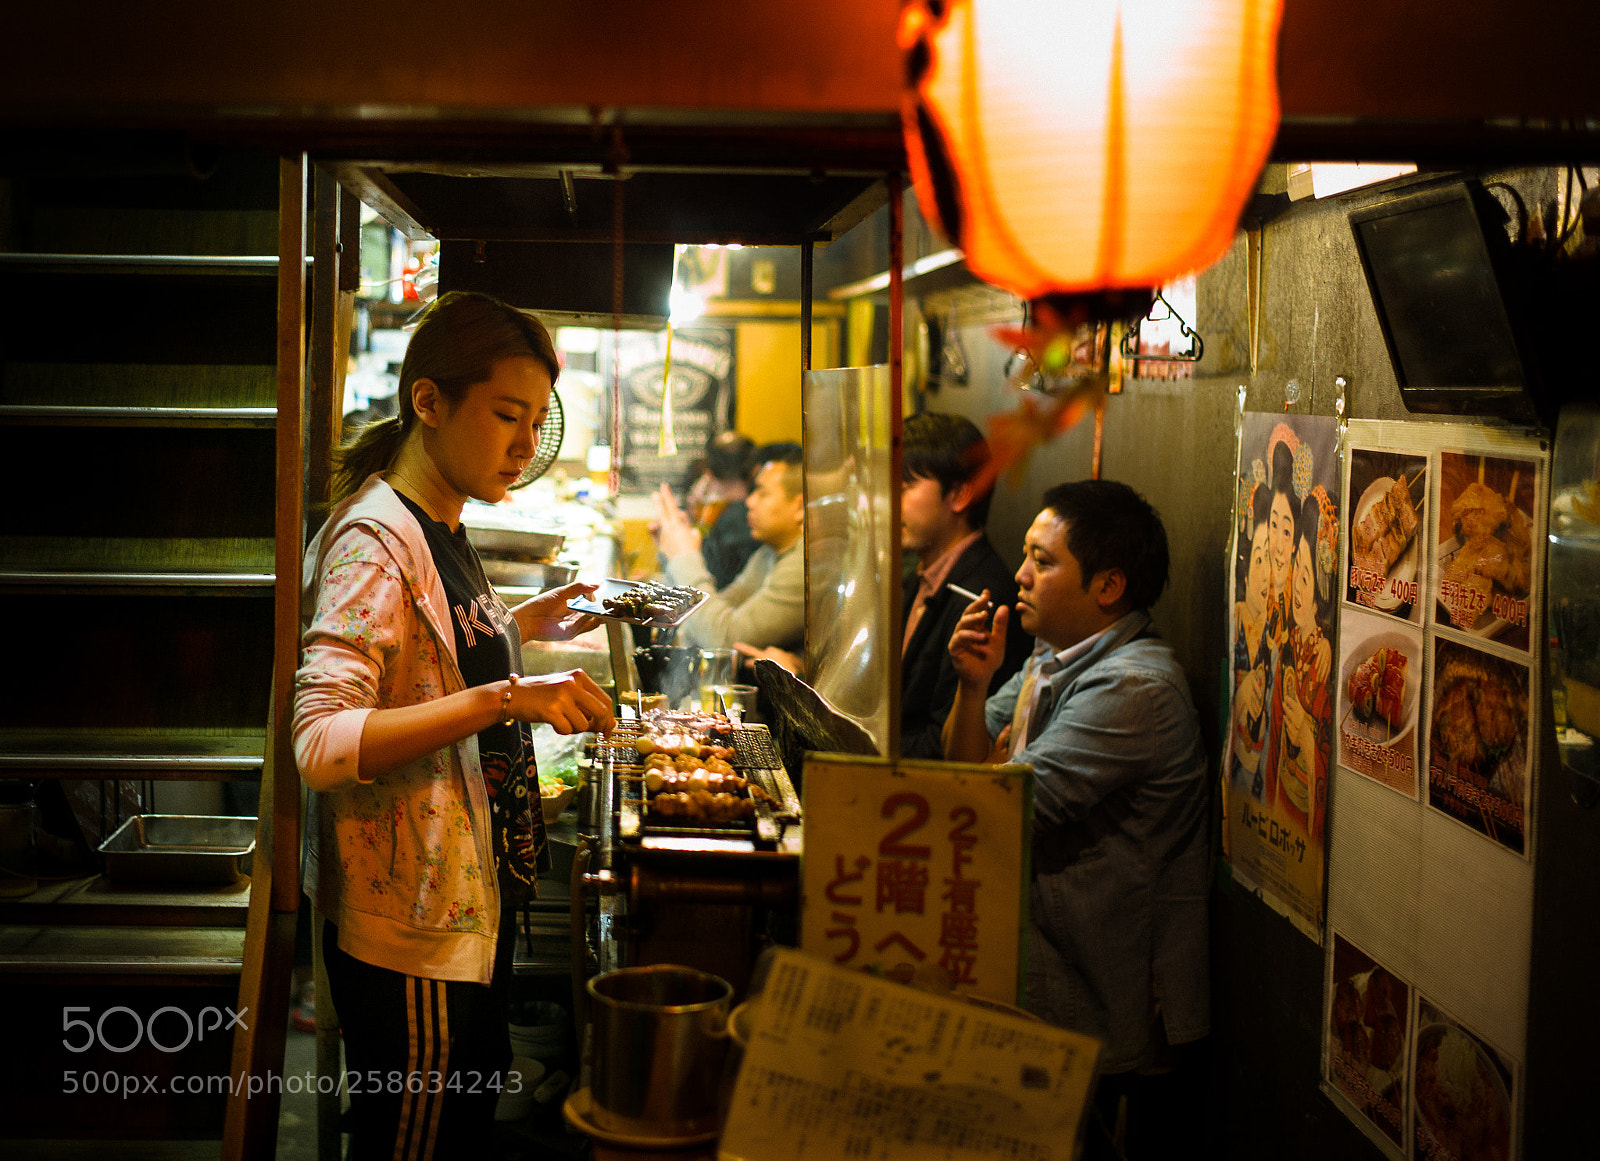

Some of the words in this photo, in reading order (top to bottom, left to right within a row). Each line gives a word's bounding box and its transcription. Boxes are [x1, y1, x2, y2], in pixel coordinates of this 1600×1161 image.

[1390, 578, 1418, 605] 400円
[1492, 594, 1528, 628] 400円
[825, 853, 871, 963] どう
